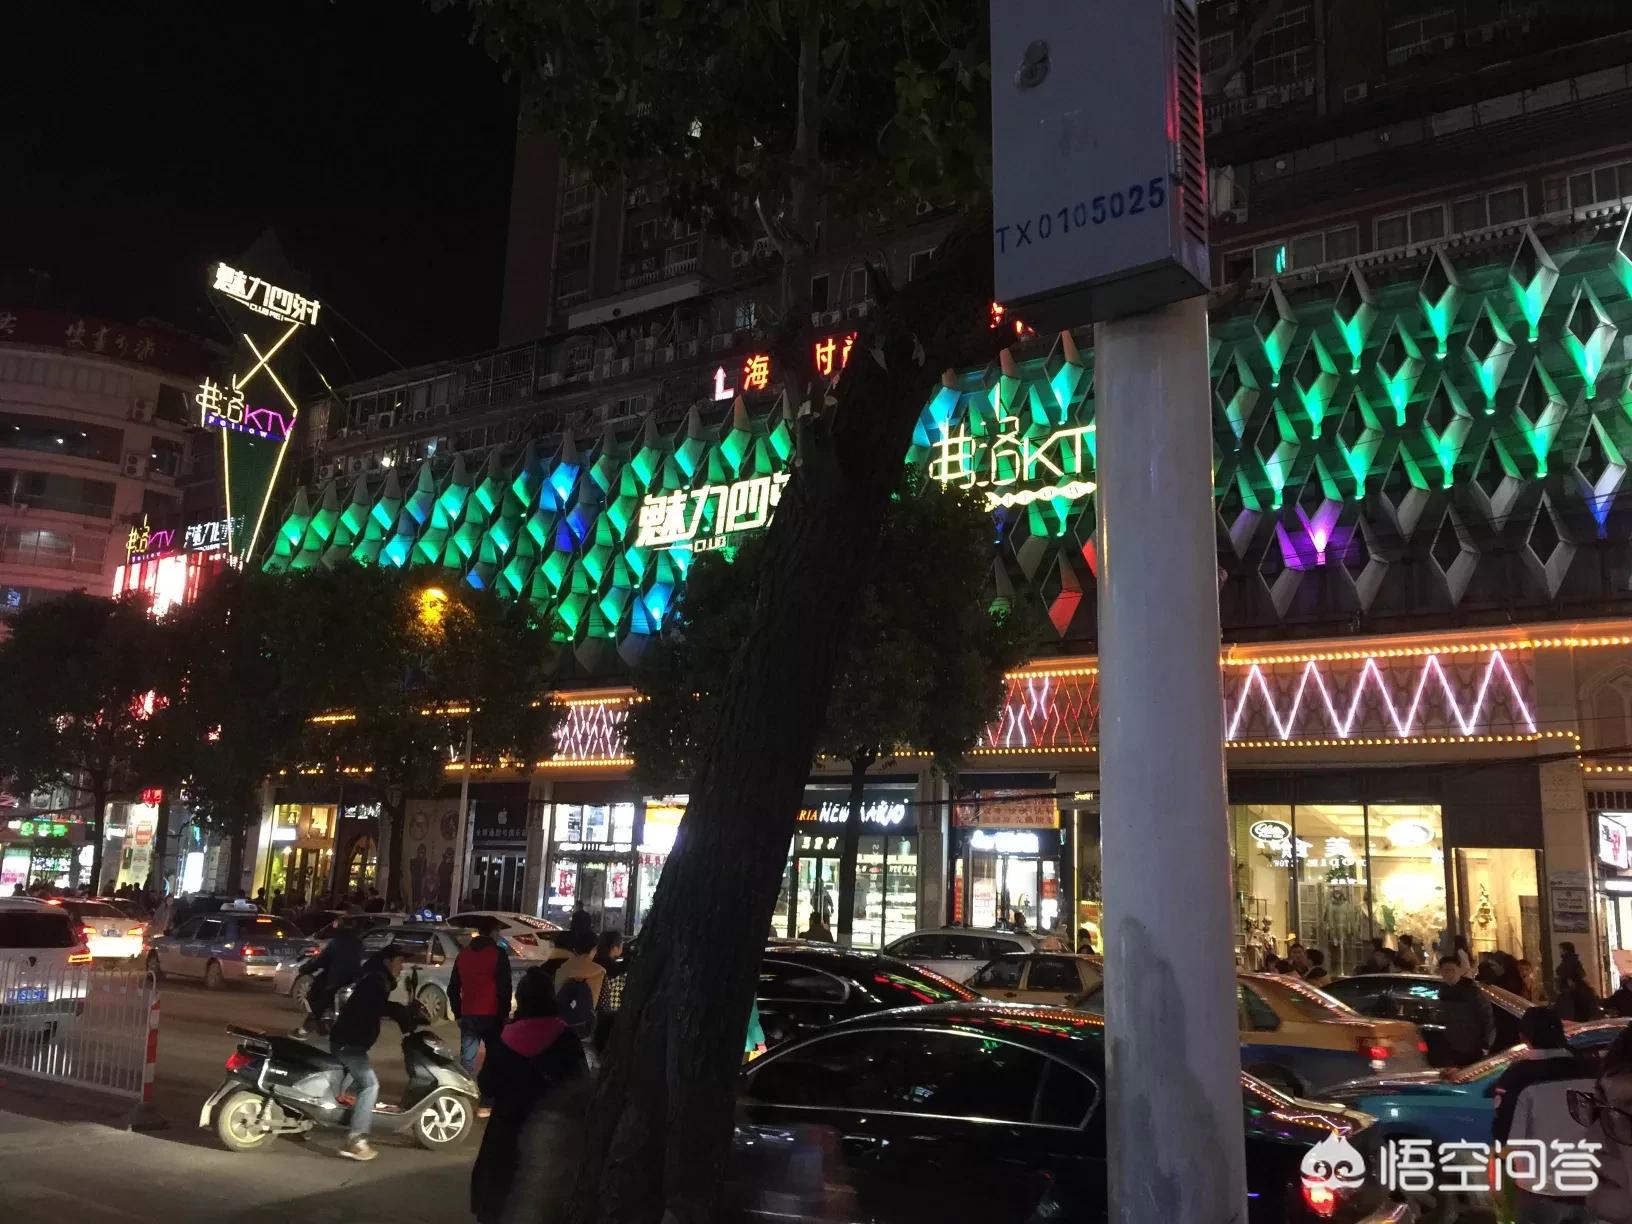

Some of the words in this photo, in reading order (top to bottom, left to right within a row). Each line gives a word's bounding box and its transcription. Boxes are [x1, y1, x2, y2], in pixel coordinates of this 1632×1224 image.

[996, 177, 1166, 253] TX0105025
[213, 262, 321, 326] 魅力四射
[743, 354, 770, 391] 海
[819, 801, 851, 823] NEW
